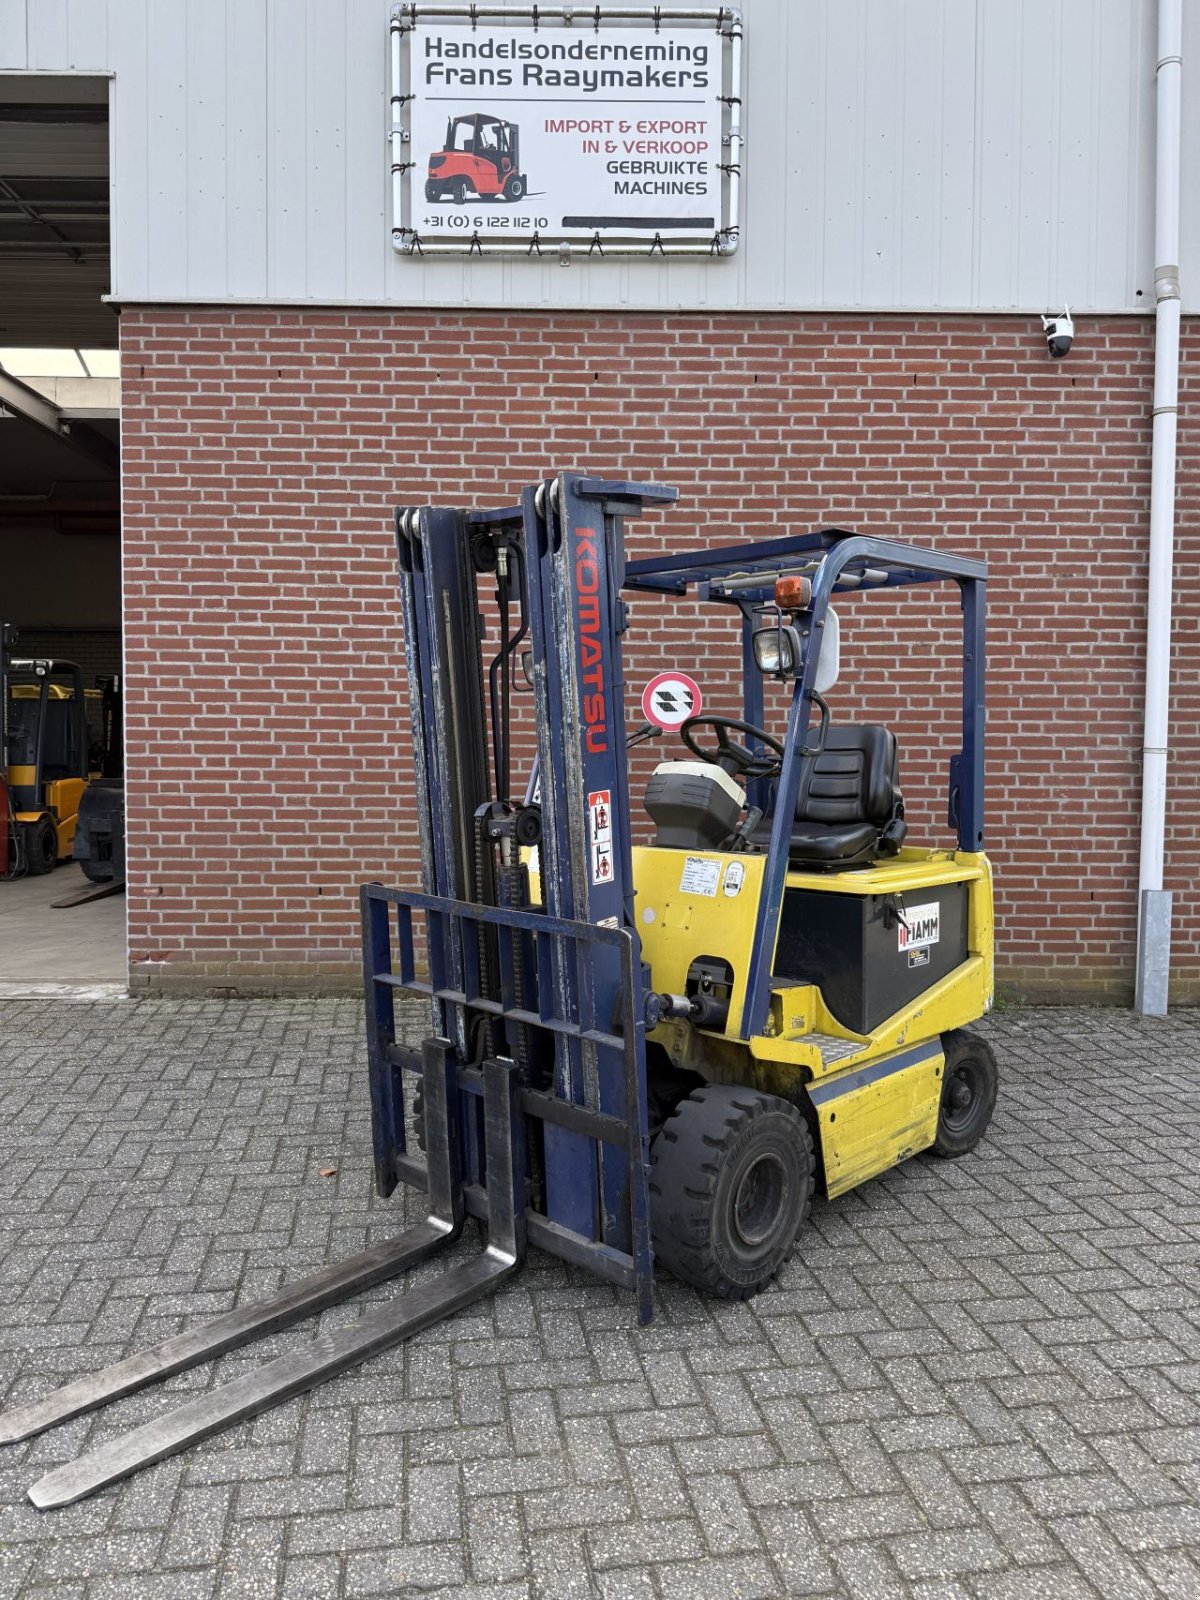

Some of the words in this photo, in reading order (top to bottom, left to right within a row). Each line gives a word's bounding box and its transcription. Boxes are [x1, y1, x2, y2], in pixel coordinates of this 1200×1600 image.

[425, 37, 708, 66] Handelsonderneming
[425, 62, 513, 86] Frans
[523, 63, 709, 92] Raaymakers
[544, 119, 614, 134] IMPORT
[619, 120, 632, 134] &
[636, 120, 708, 134] EXPORT
[582, 140, 600, 154] IN
[605, 140, 618, 154] &
[623, 140, 708, 154] VERKOOP
[606, 160, 708, 175] GEBRUIKTE
[614, 181, 708, 195] MACHINES
[423, 216, 443, 227] +31
[447, 215, 470, 228] (0)
[473, 216, 483, 227] 6
[487, 217, 510, 228] 122
[513, 217, 531, 228] 112
[534, 217, 549, 228] 10
[575, 527, 606, 753] KOMATSU
